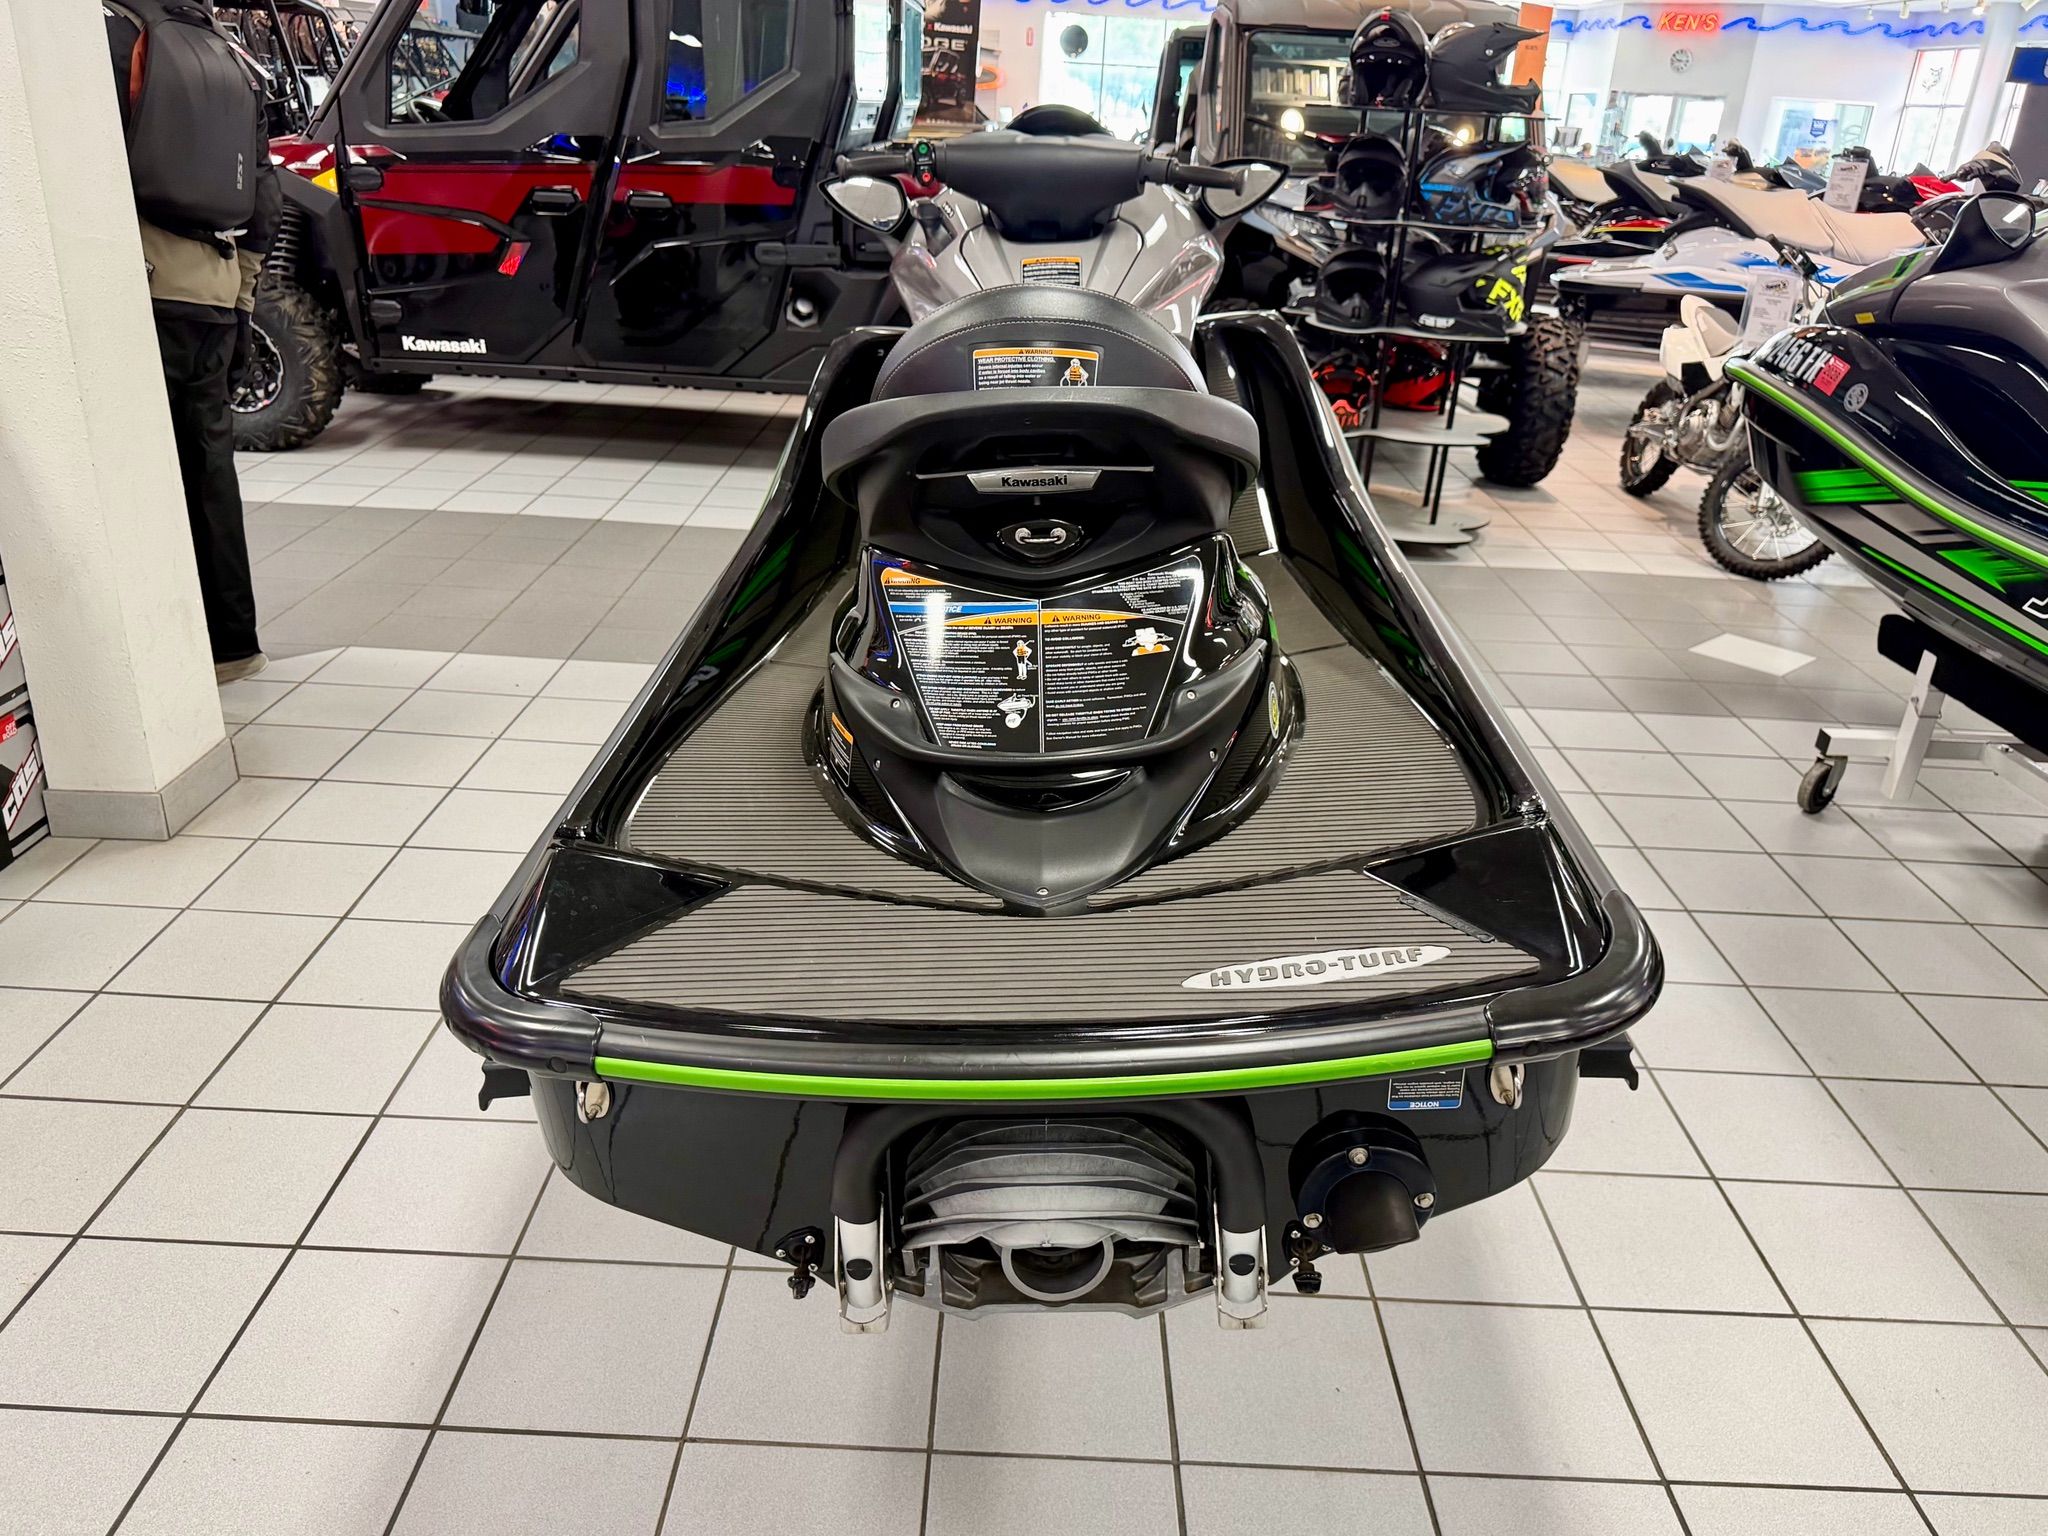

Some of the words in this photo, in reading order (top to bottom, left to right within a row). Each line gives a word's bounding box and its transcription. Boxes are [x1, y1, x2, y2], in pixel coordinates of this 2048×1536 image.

[933, 22, 973, 34] Kawasaki
[1657, 12, 1718, 32] KEN'S
[401, 335, 487, 354] Kawasaki
[1001, 475, 1068, 487] Kawasaki
[994, 616, 1033, 624] WARNING
[1063, 614, 1101, 622] WARNING
[5, 721, 16, 732] OFF
[1210, 947, 1423, 987] HYDRO-TURF
